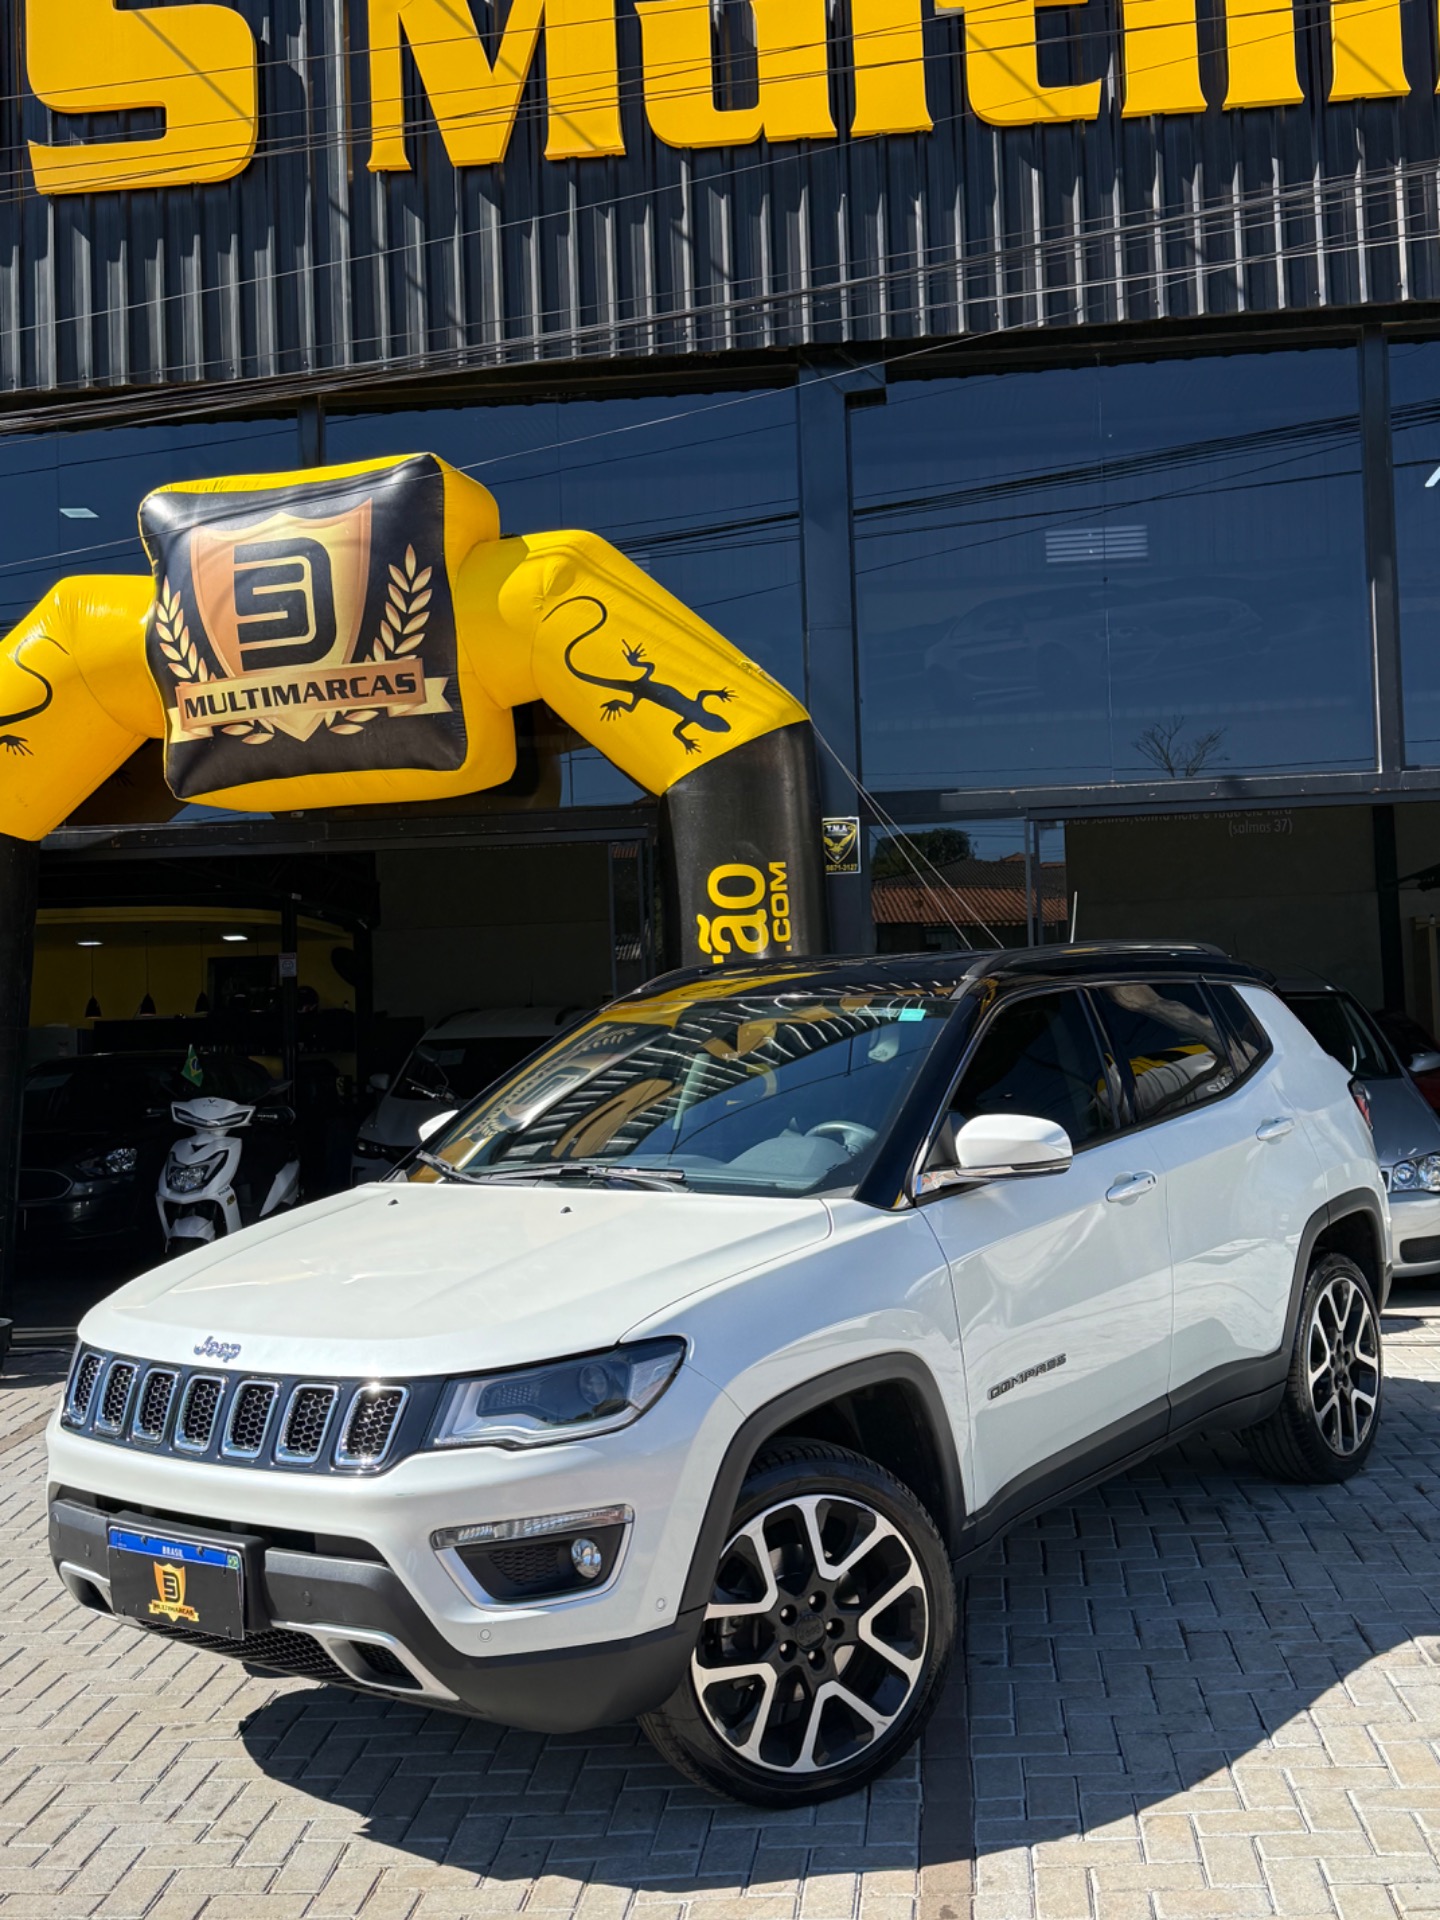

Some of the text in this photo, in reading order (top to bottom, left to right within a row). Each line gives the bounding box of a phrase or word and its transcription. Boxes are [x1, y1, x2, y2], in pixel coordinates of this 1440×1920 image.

[184, 672, 417, 720] MULTIMARCAS
[696, 863, 769, 964] ão
[768, 861, 791, 952] .COM
[193, 1335, 242, 1363] Jeep
[987, 1352, 1067, 1400] COMPASS
[162, 1545, 184, 1559] BRASIL
